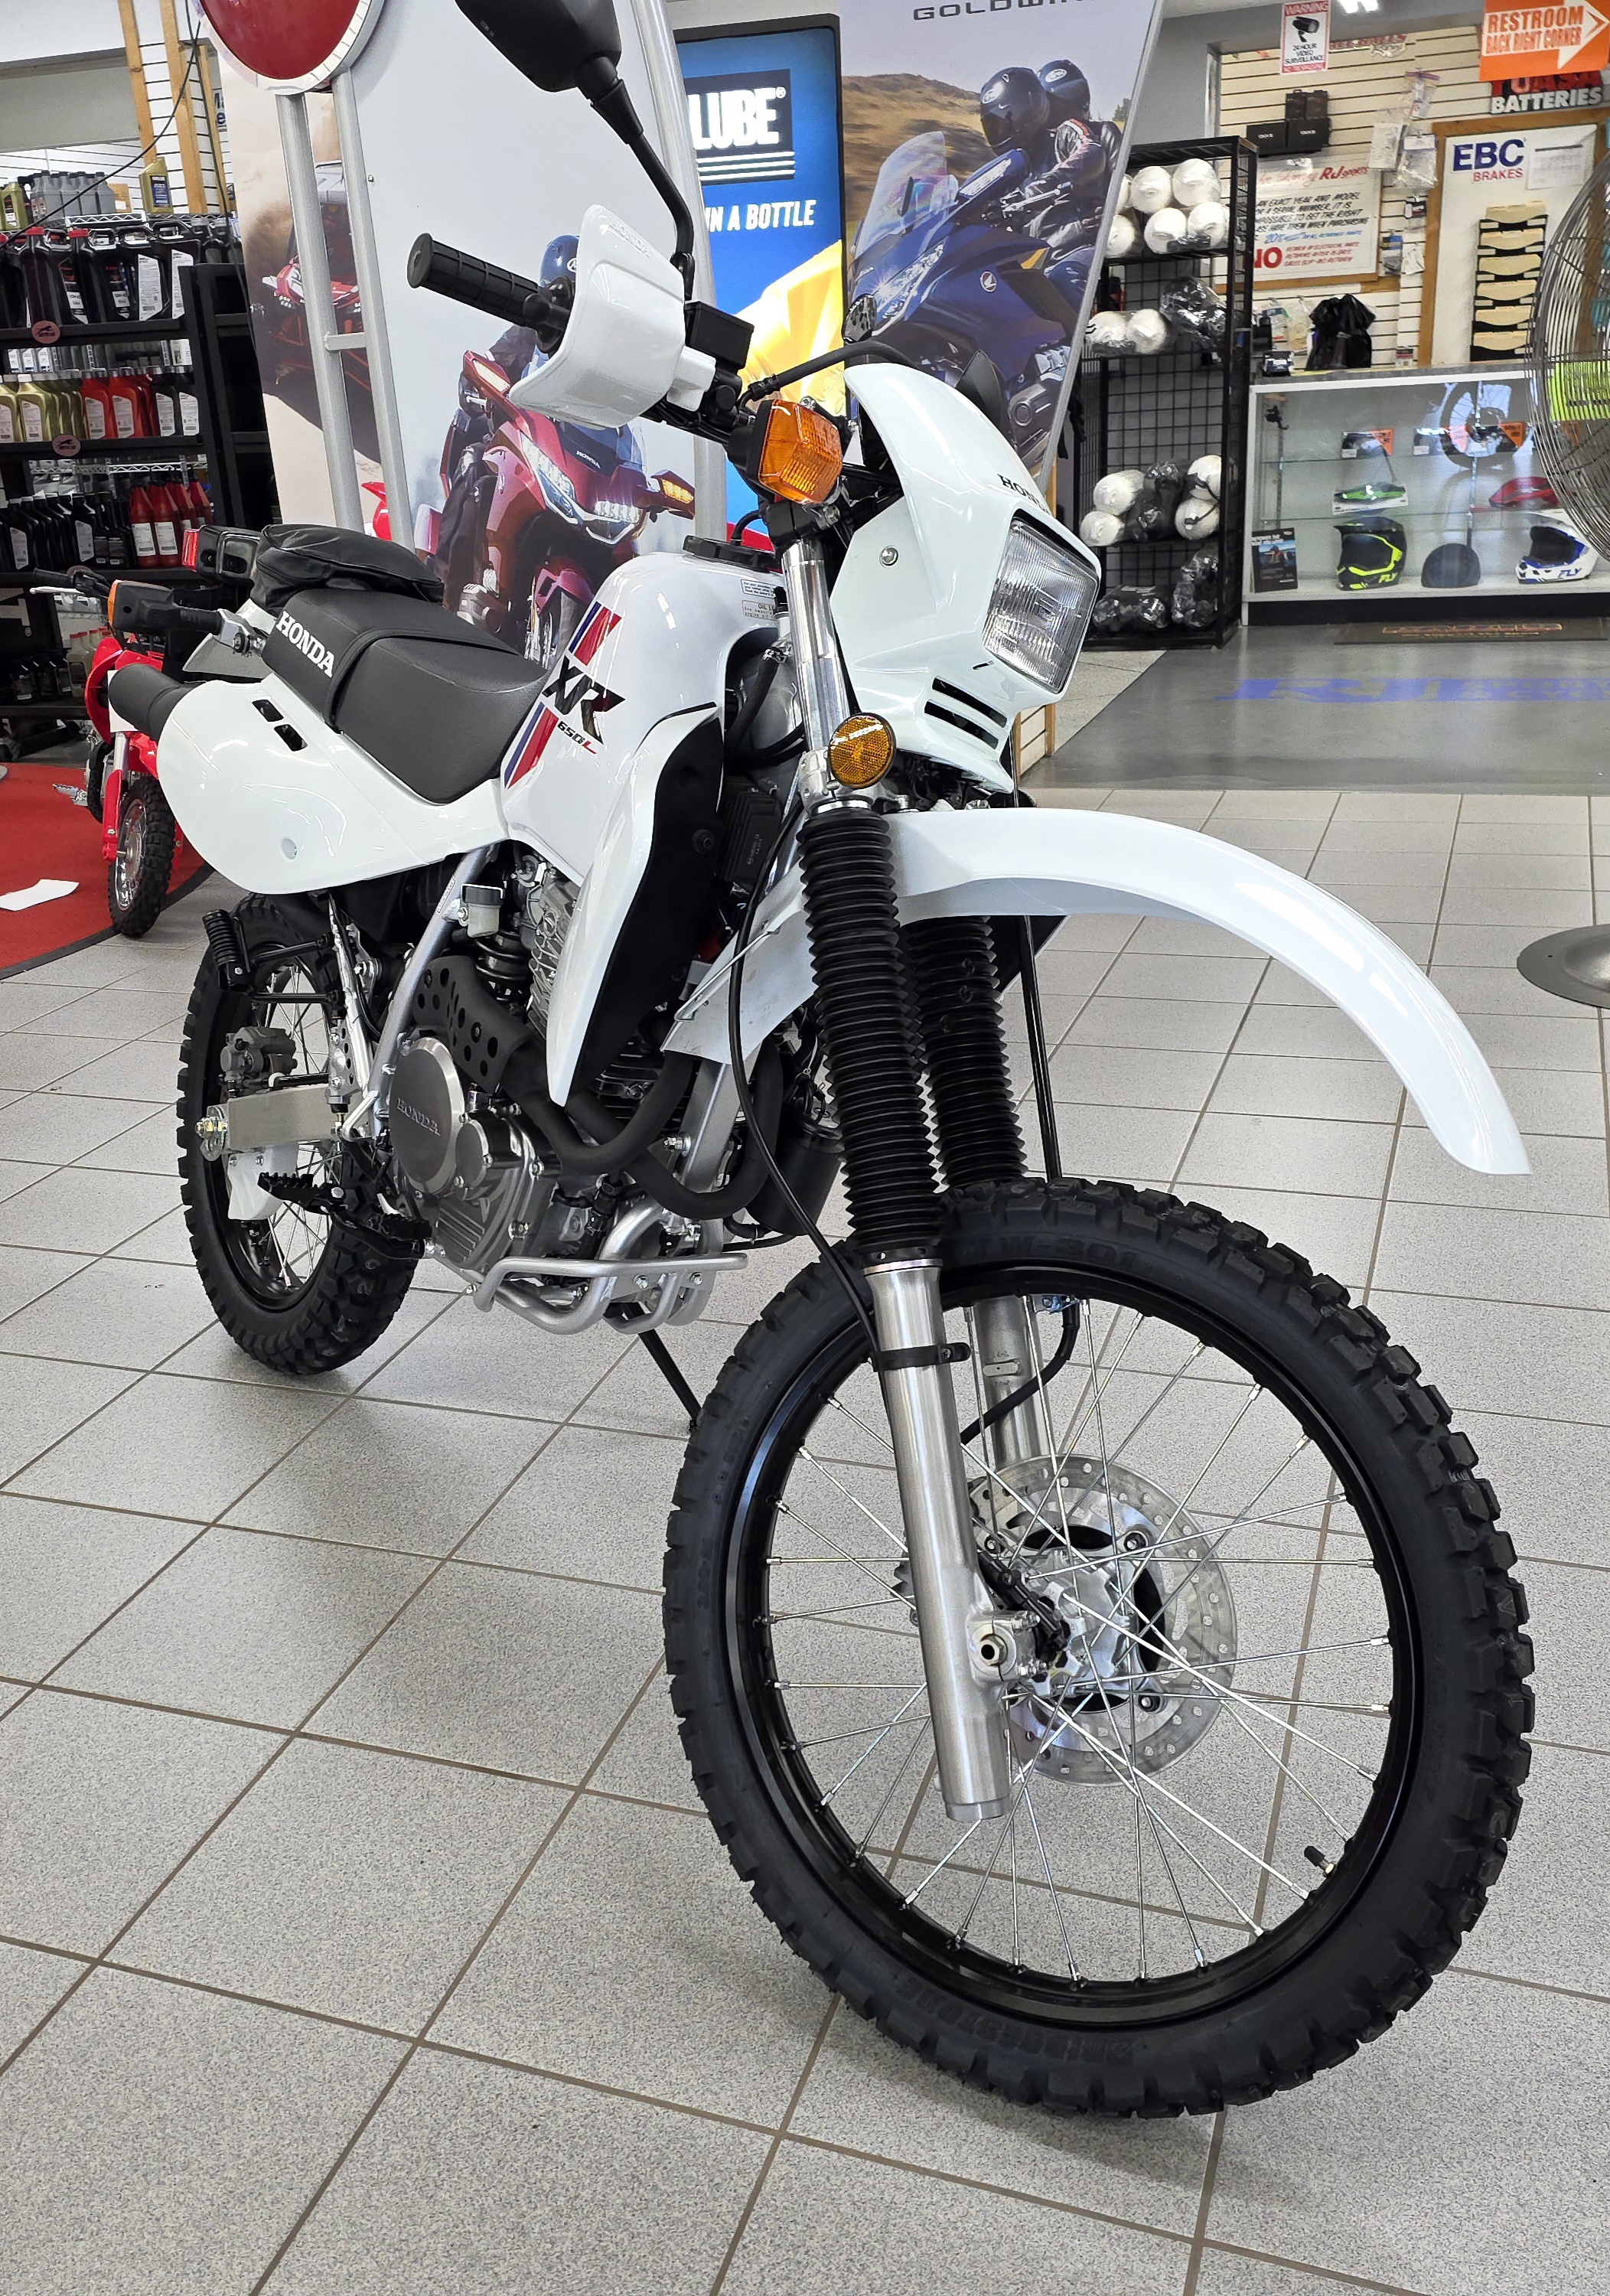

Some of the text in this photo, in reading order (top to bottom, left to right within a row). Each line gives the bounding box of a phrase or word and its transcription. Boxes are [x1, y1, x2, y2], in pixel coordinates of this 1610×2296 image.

[914, 0, 1080, 20] GOLDW
[1286, 4, 1328, 15] WARNING
[1488, 6, 1584, 34] RESTROOM
[1491, 87, 1602, 114] BATTERIES
[1453, 139, 1524, 171] EBC
[1473, 168, 1524, 182] BRAKES
[727, 205, 741, 231] A
[745, 199, 817, 230] BOTTLE
[575, 450, 601, 469] HONDA
[997, 474, 1051, 516] HONDA
[1379, 572, 1399, 583] FLY
[1557, 567, 1582, 579] FLY
[275, 610, 334, 678] HONDA
[542, 654, 626, 745] XR
[557, 720, 597, 755] 650L
[396, 1097, 441, 1137] HONDA
